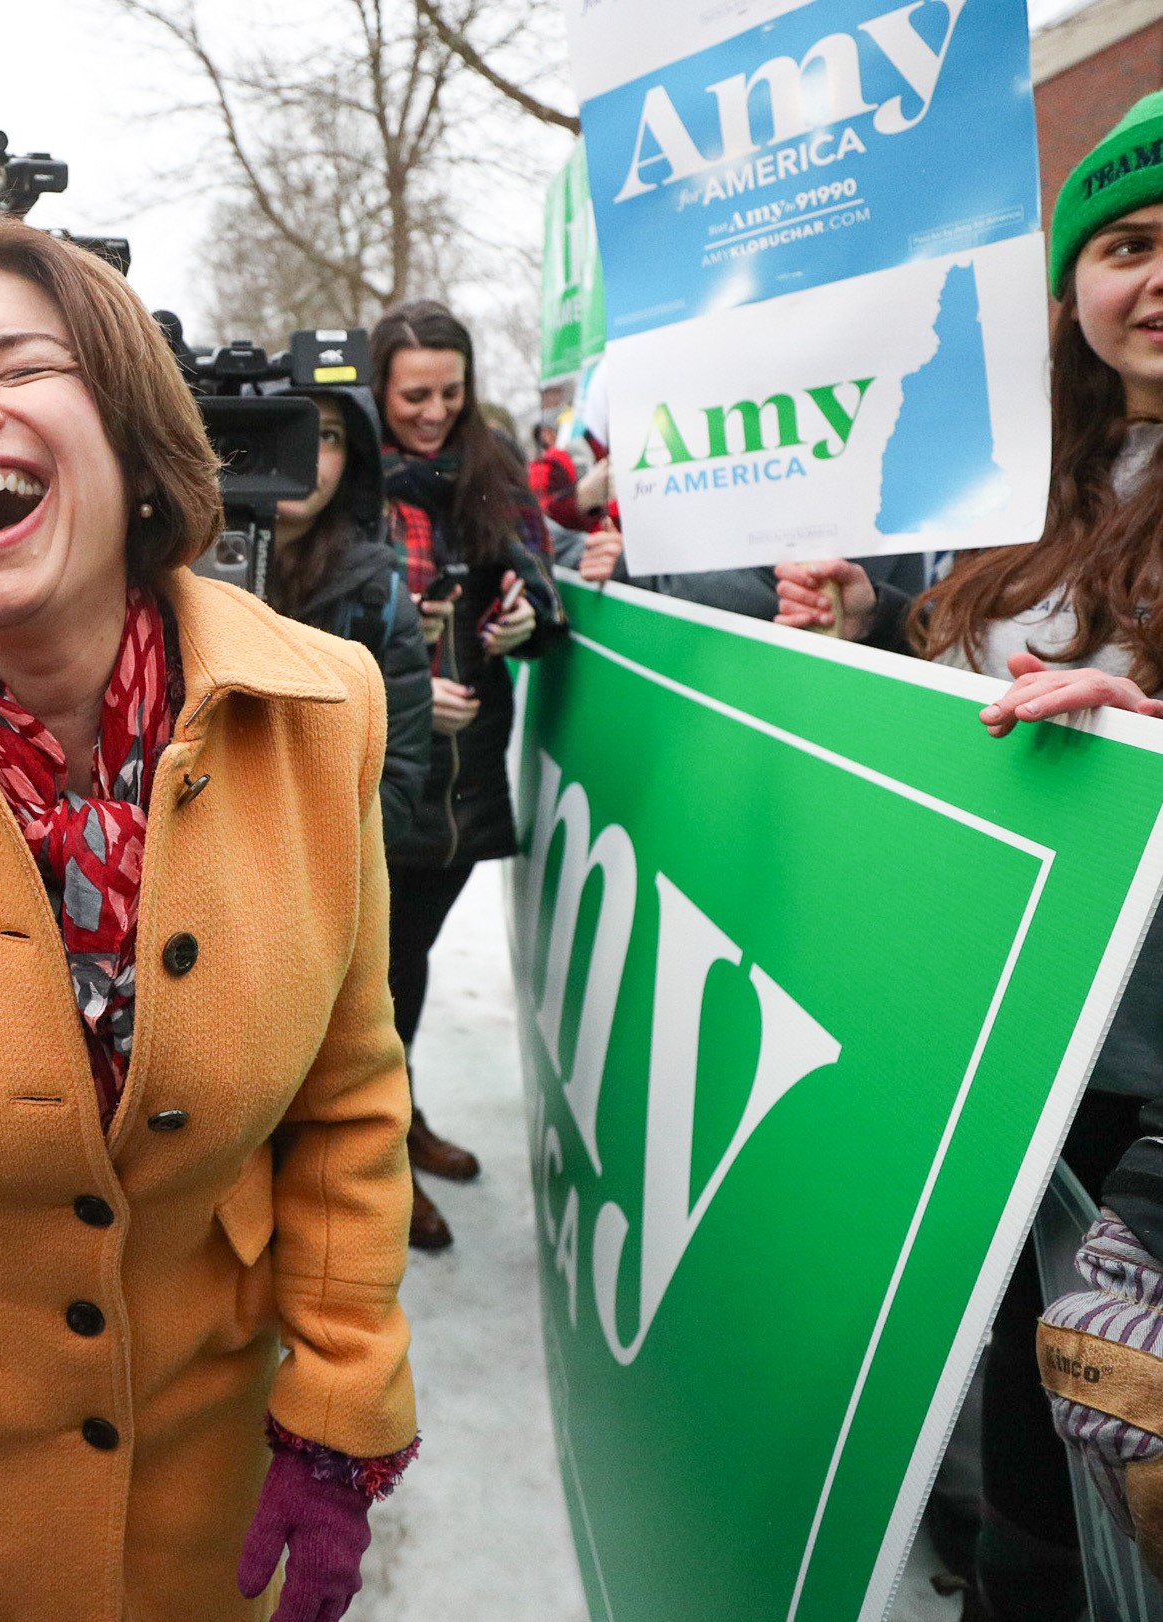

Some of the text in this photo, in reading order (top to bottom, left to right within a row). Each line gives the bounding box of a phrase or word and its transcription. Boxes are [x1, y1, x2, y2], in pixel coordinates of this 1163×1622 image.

[613, 0, 967, 203] Amy
[702, 126, 868, 207] AMERICA
[727, 200, 787, 232] Amy
[794, 177, 858, 212] 91990
[1081, 138, 1163, 201] TEAM
[629, 376, 878, 473] Amy
[633, 456, 808, 500] for AMERICA
[528, 747, 843, 1366] my
